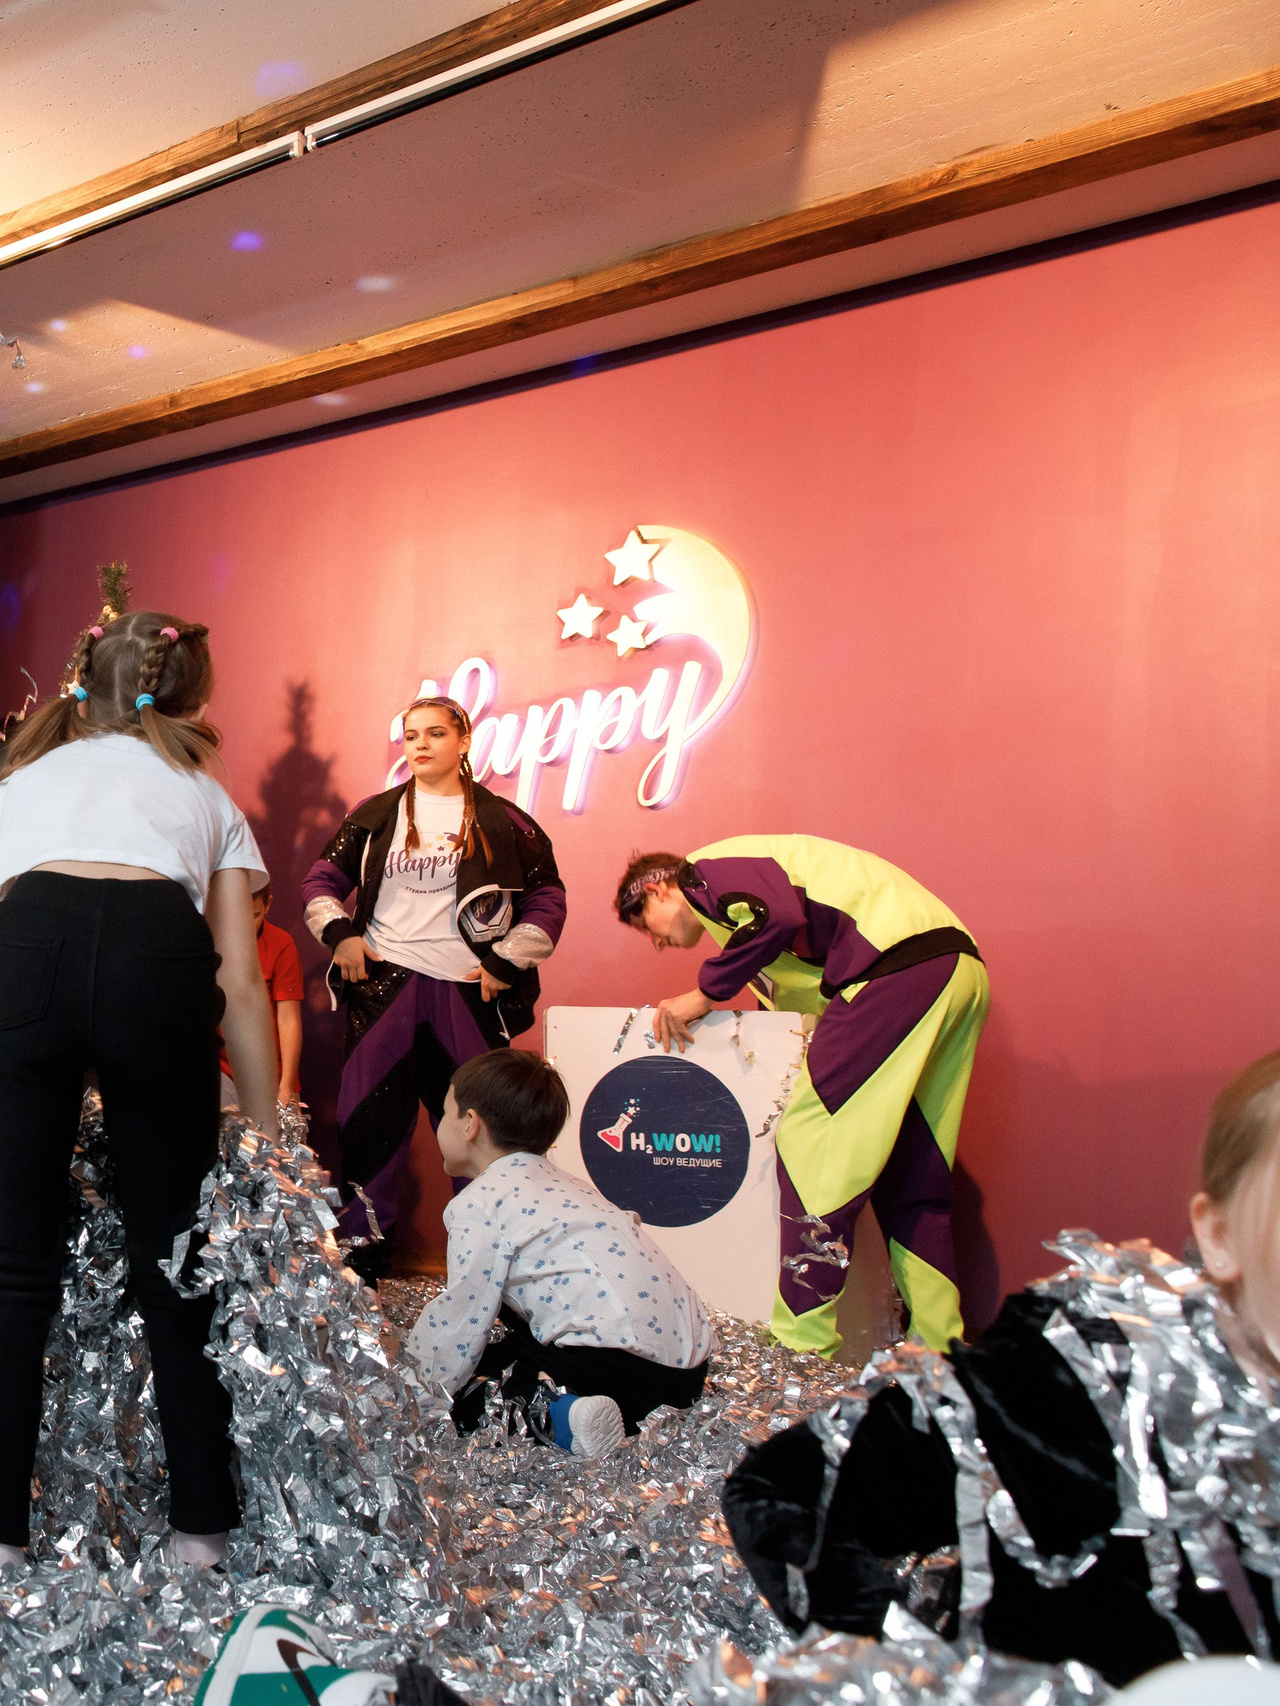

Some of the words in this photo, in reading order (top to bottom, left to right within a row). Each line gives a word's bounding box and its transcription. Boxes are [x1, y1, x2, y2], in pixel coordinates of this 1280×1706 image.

[384, 849, 461, 881] Happy
[405, 886, 427, 894] студия
[653, 1157, 675, 1166] ШОУ
[676, 1157, 723, 1168] ВЕДУЩИЕ
